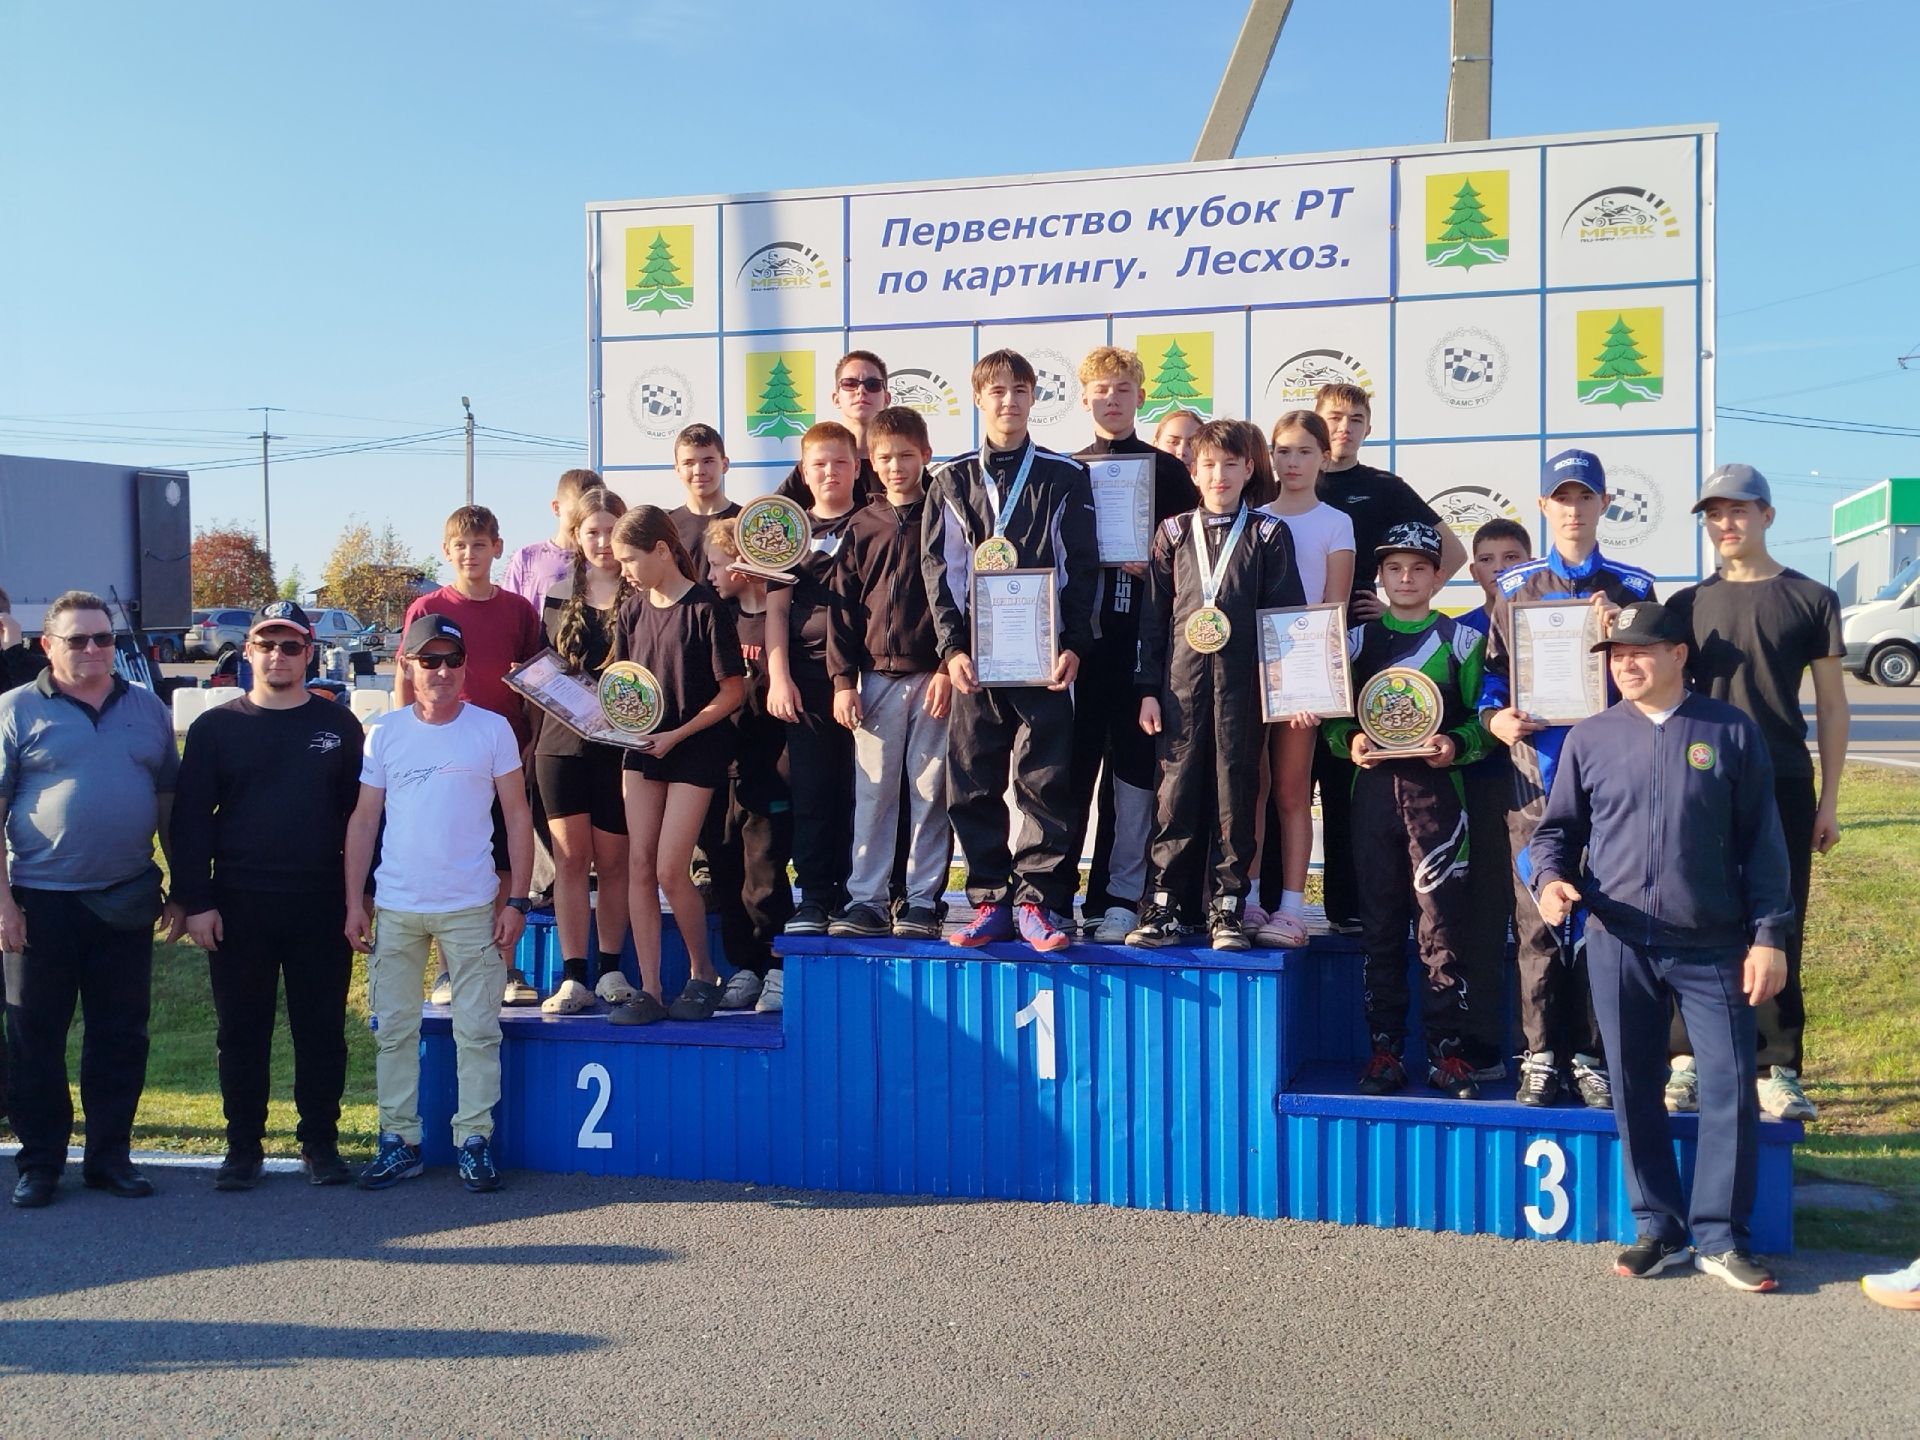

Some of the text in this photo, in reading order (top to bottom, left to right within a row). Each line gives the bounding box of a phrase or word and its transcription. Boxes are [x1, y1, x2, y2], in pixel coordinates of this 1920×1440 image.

[881, 187, 1355, 252] Первенство кубок РТ
[878, 244, 1350, 296] по картингу. Лесхоз.
[1449, 398, 1474, 406] ФАМС
[1602, 537, 1640, 546] ФАМС РТ
[1015, 988, 1056, 1080] 1
[576, 1062, 612, 1150] 2
[1524, 1139, 1569, 1236] 3
